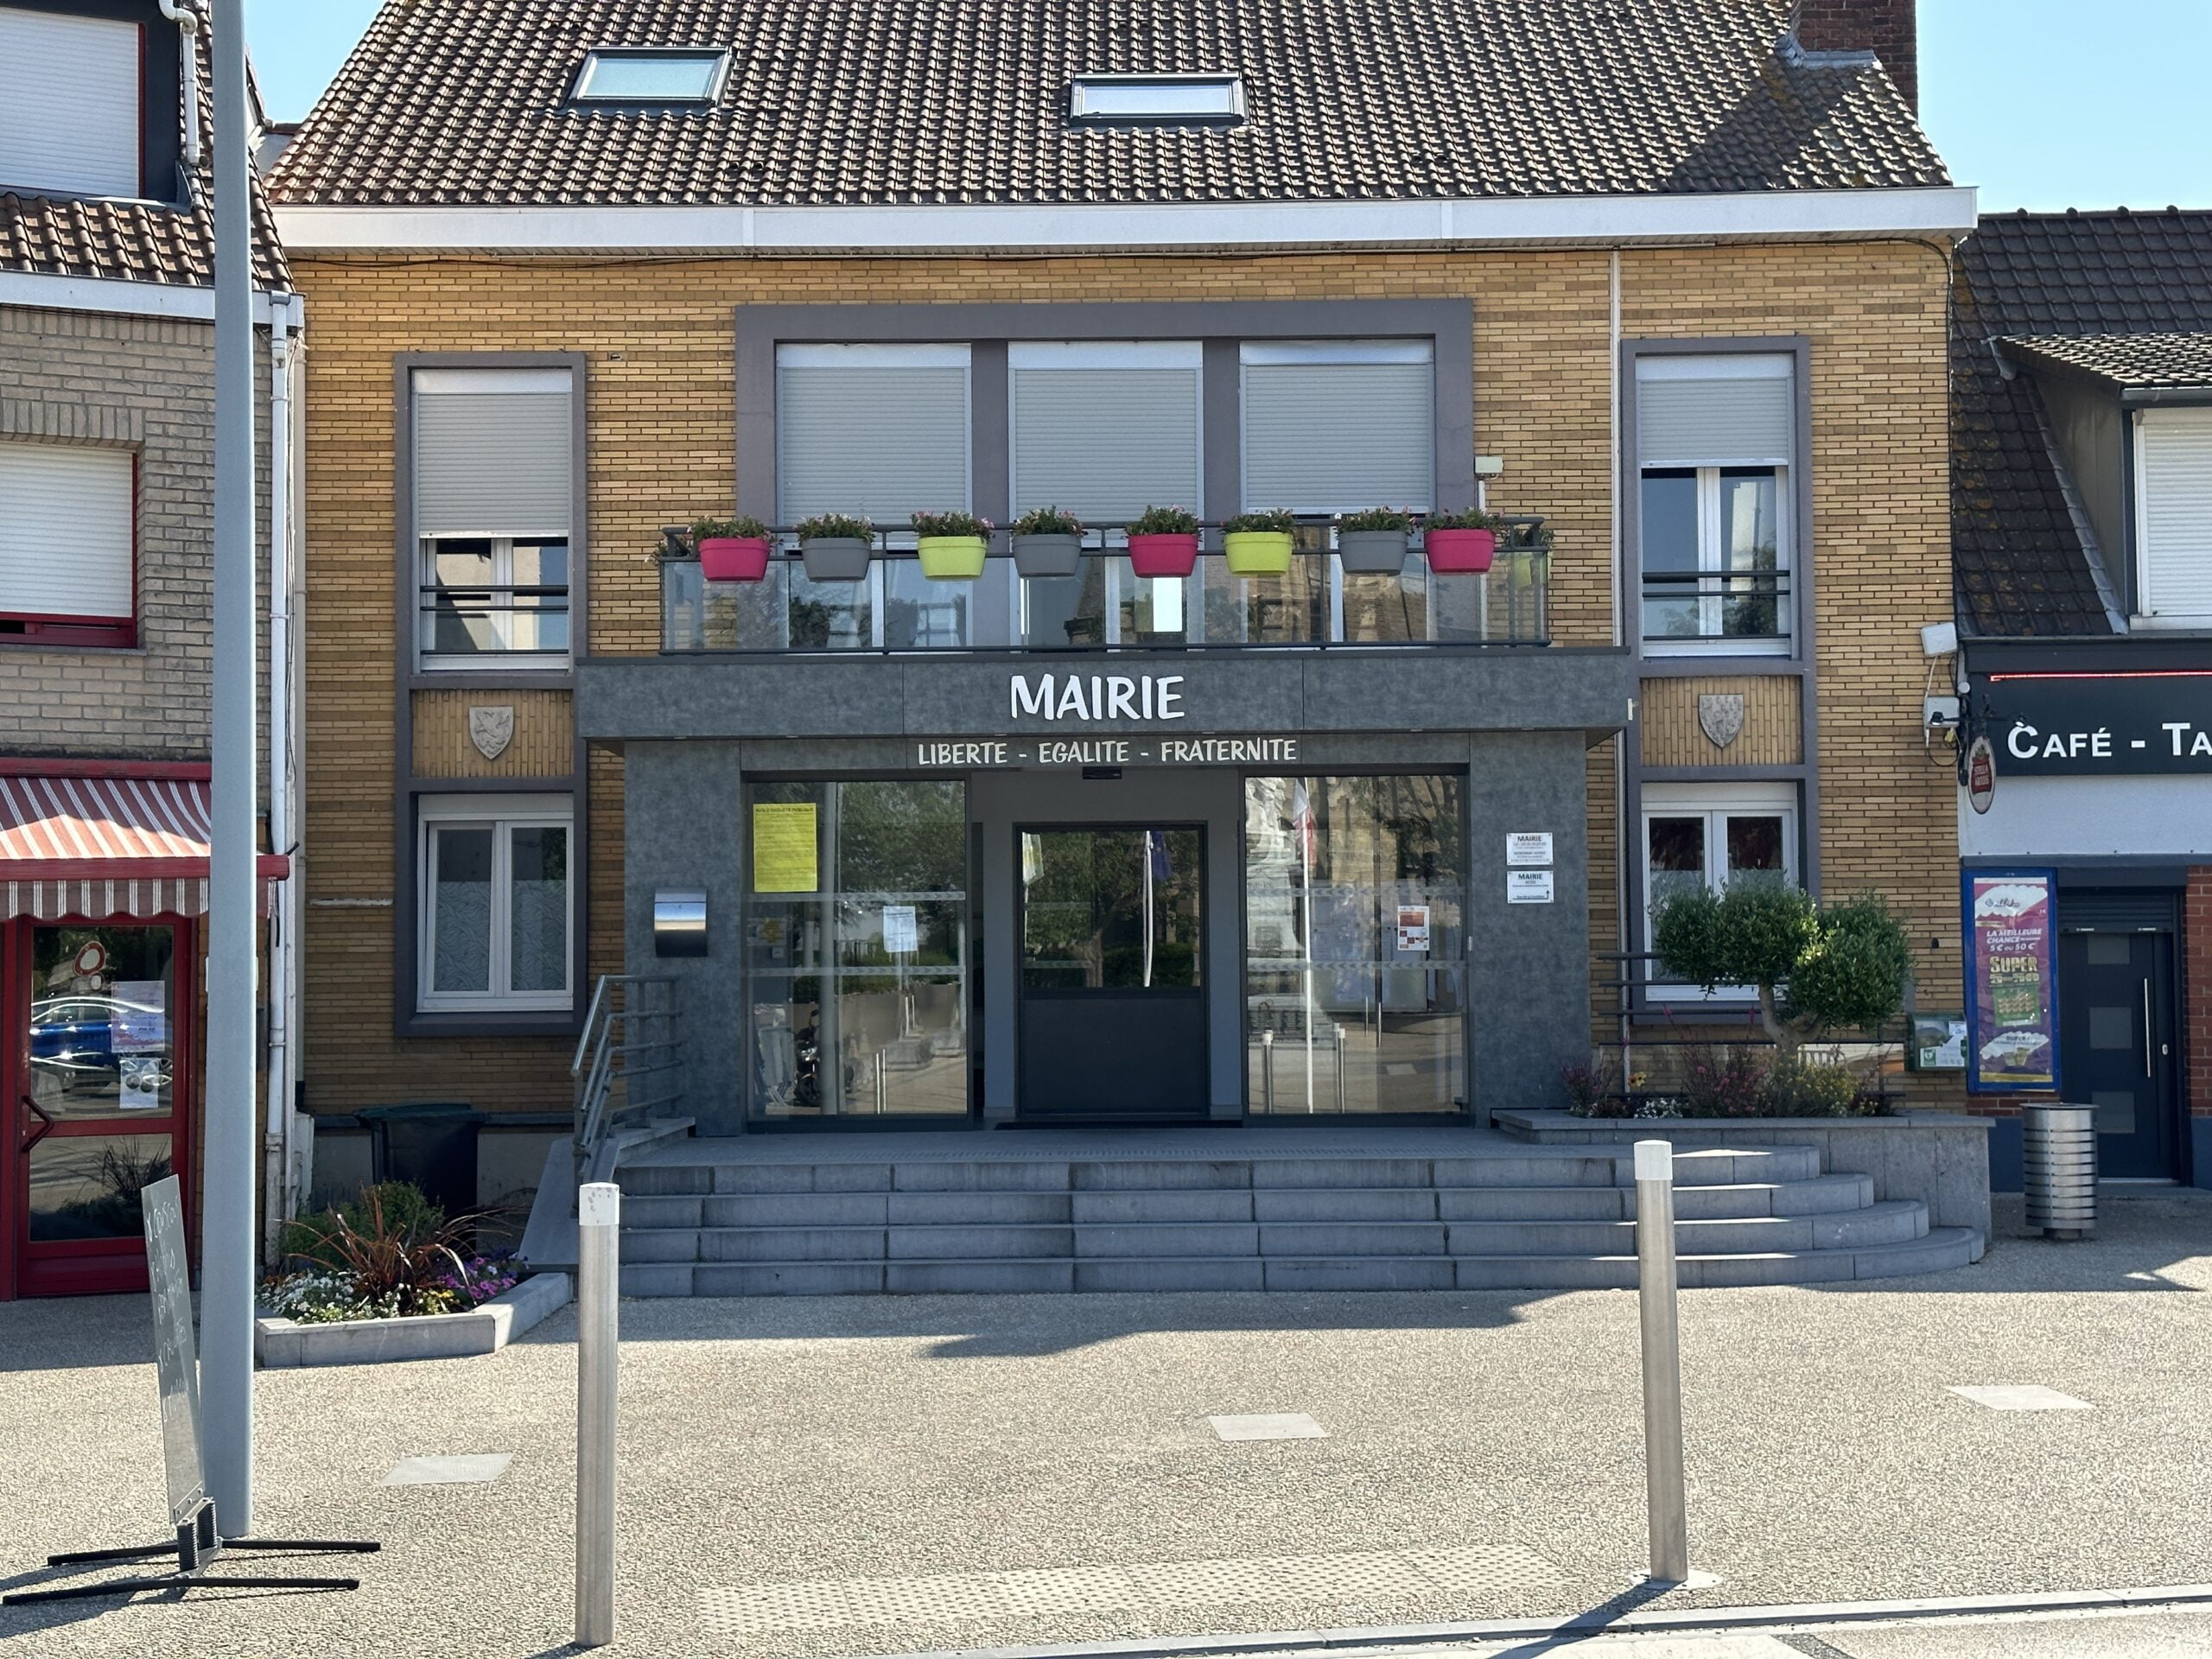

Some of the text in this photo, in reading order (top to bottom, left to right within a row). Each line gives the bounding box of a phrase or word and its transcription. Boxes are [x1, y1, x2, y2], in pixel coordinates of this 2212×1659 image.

[1010, 673, 1185, 721] MAIRIE
[918, 741, 1008, 766] LIBERTE
[1039, 741, 1129, 764] EGALITE
[1160, 737, 1297, 762] FRATERNITE
[2007, 723, 2112, 759] CAFÉ
[1989, 956, 2037, 973] SUPER
